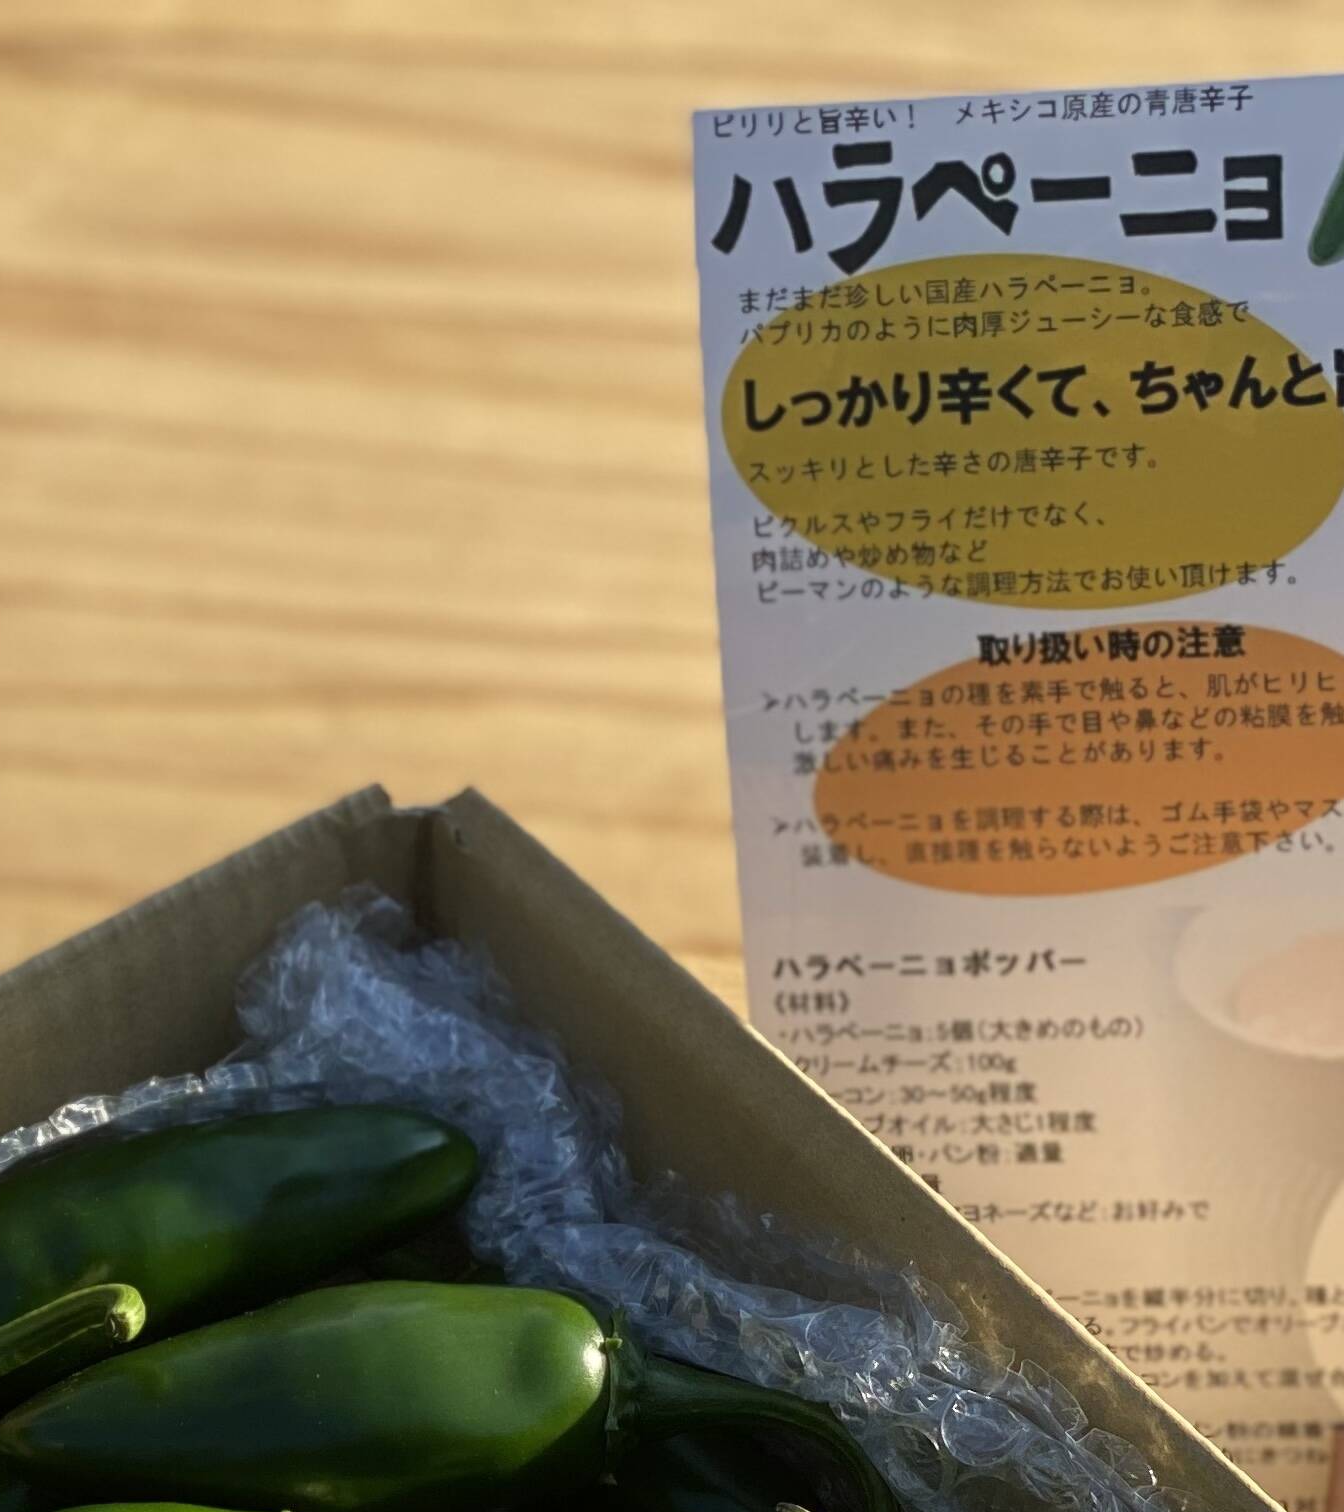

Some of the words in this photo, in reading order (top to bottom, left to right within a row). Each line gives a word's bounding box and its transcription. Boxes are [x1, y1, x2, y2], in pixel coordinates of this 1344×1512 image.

[712, 104, 917, 139] ピリリと旨辛い！
[955, 84, 1254, 126] メキシコ原産の青唐辛子
[711, 141, 1284, 275] ハラペーニョ
[739, 273, 1152, 314] まだまだ珍しい国産ハラペーニョ。
[739, 299, 1249, 346] パプリカのように肉厚ジューシーな食感で
[749, 442, 1159, 485] スッキリとした辛さの唐辛子です。
[753, 501, 1106, 538] ピクルスやフライだけでなく、
[752, 540, 987, 573] 肉詰めや炒め物など
[757, 561, 1298, 604] ピーマンのような調理方法でお使い頂けます。
[977, 625, 1246, 667] 取り扱い時の注意
